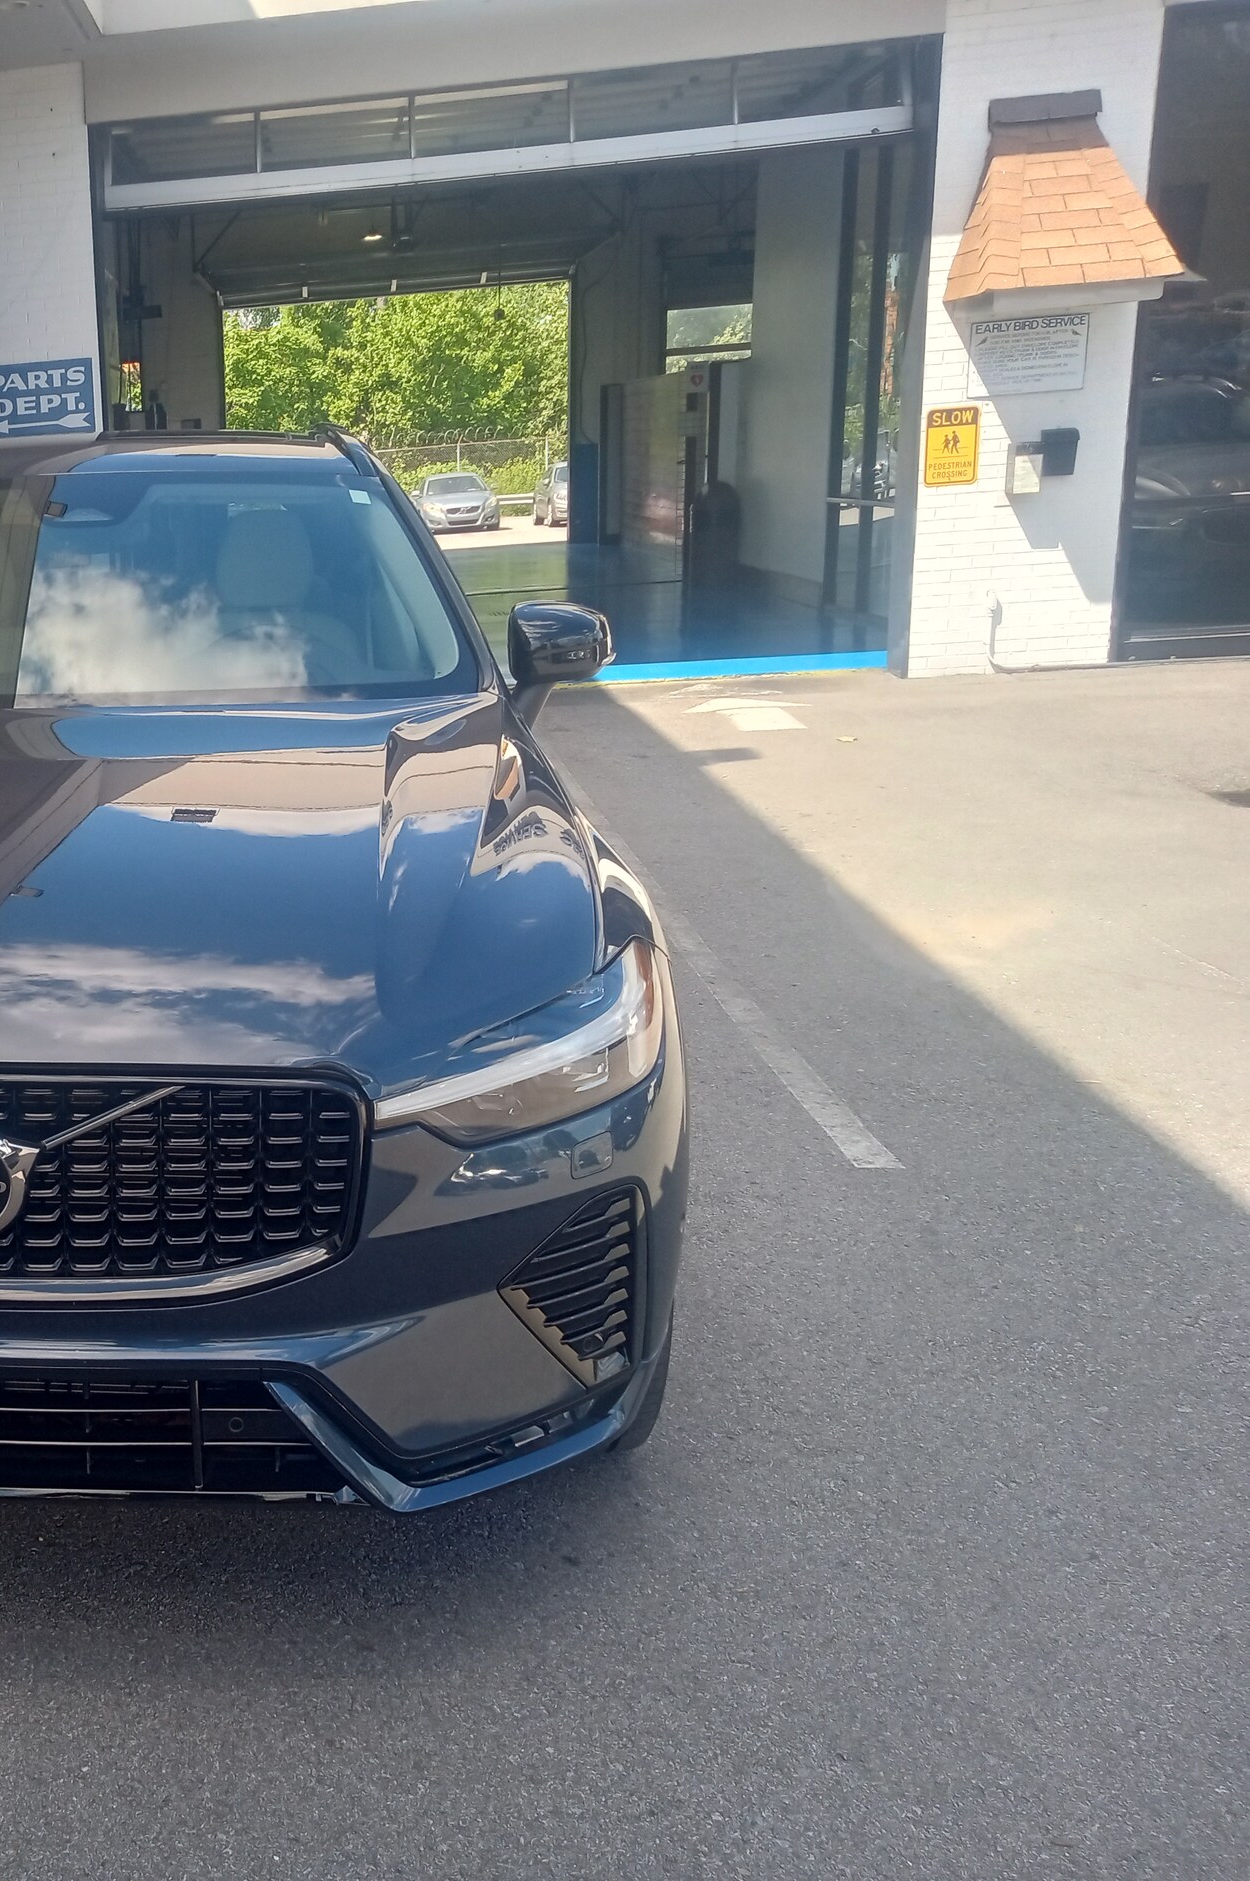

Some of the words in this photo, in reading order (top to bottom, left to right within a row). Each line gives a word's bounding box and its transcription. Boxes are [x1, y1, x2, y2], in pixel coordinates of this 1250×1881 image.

[975, 322, 1012, 335] EARLY
[1013, 319, 1039, 331] BIRD
[1040, 315, 1086, 328] SERVICE
[932, 409, 974, 426] SLOW
[929, 461, 972, 471] PEDESTRIAN
[932, 469, 968, 479] CROSSING
